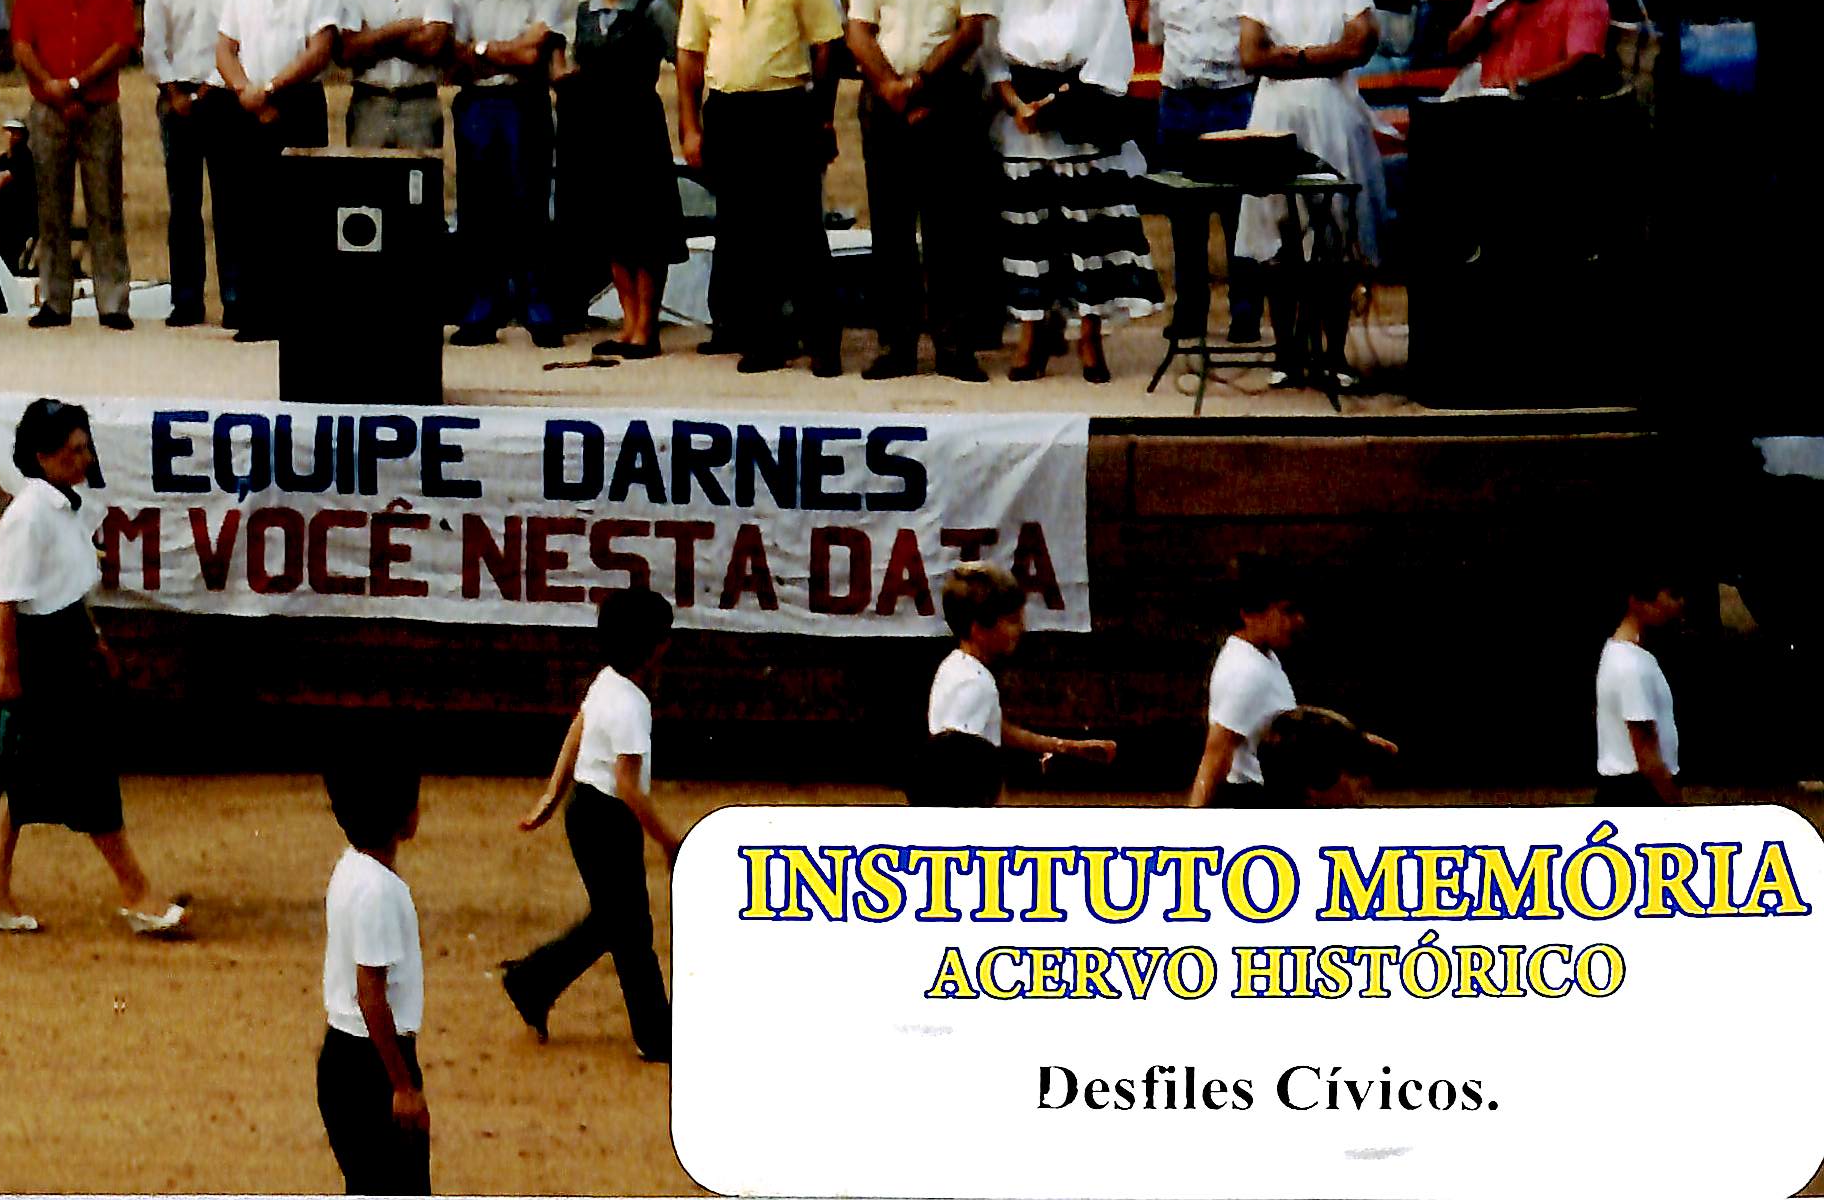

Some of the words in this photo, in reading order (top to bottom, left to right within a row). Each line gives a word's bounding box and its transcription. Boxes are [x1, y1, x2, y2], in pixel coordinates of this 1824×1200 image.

[151, 410, 483, 502] EQUIPE
[543, 418, 928, 512] DARNES
[188, 496, 430, 598] VOCÊ
[462, 512, 779, 612] NESTA
[808, 521, 1066, 617] DATA
